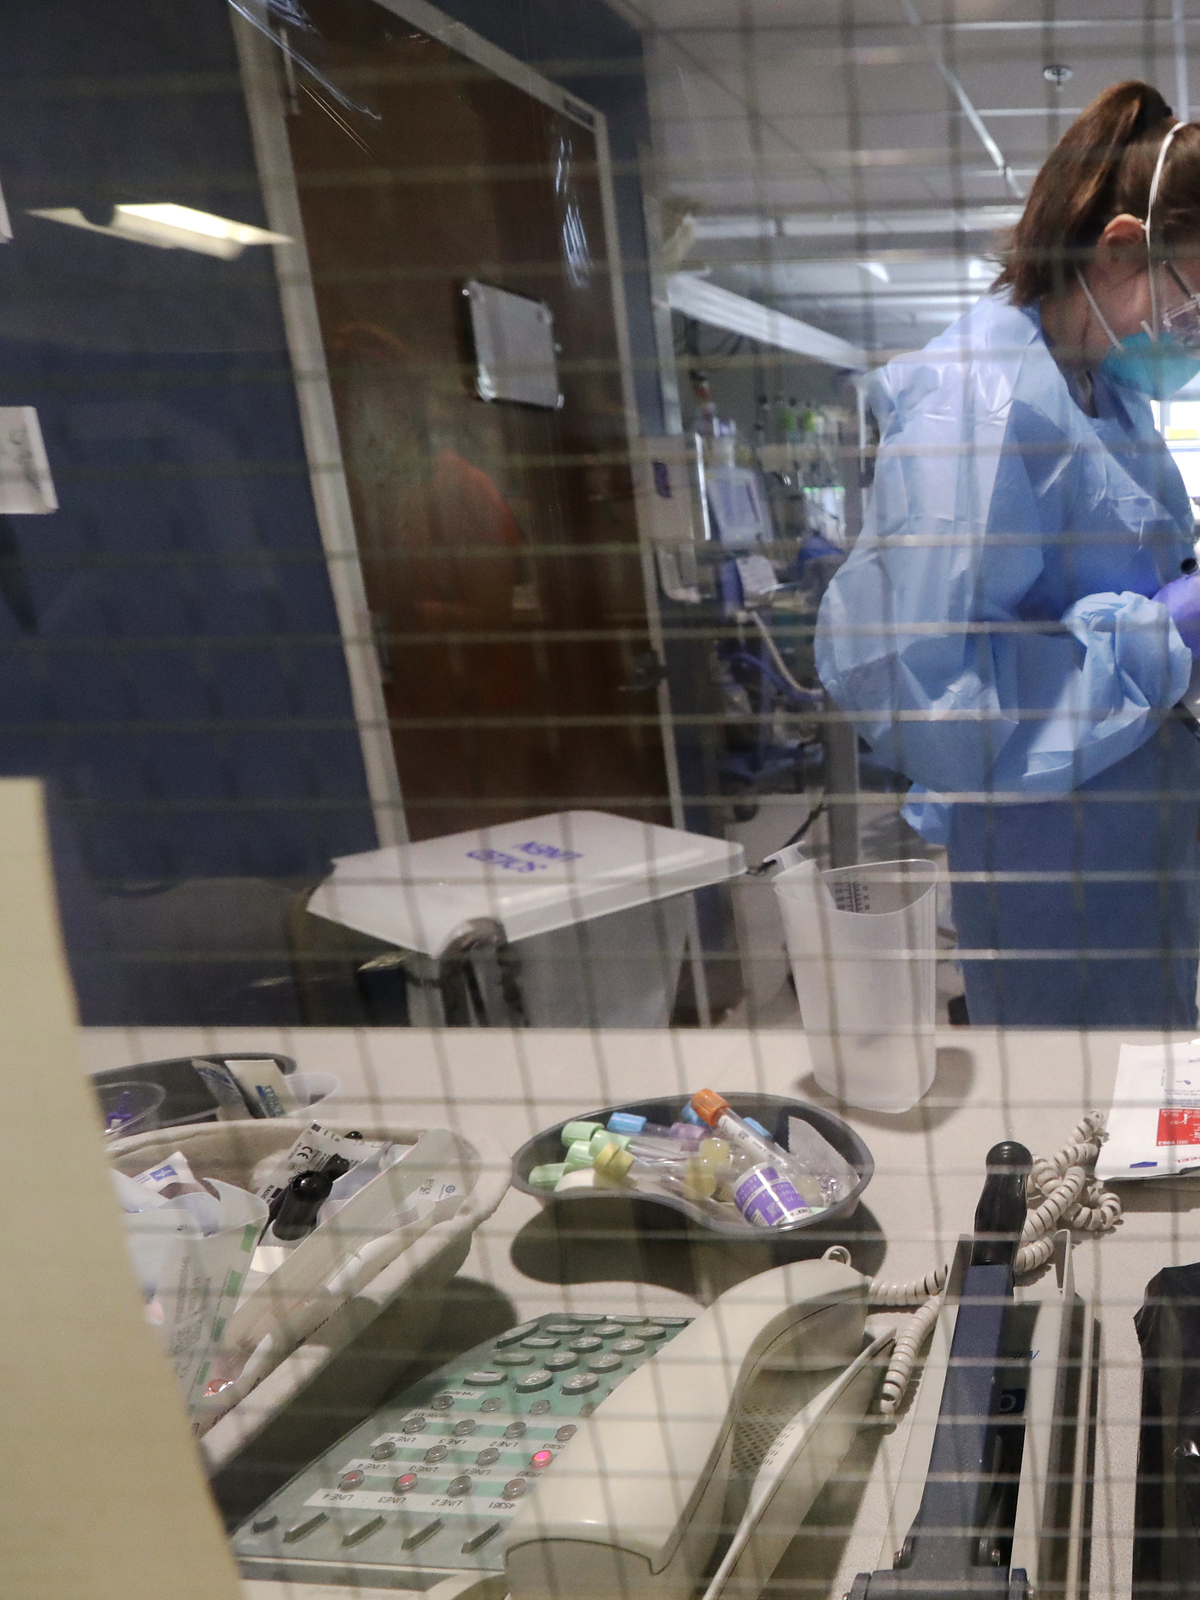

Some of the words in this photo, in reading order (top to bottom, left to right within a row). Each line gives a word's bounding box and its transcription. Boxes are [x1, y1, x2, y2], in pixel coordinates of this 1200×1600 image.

[397, 1435, 417, 1444] LINE
[447, 1438, 468, 1446] LINE
[499, 1440, 520, 1449] LINE
[365, 1463, 387, 1471] LINE
[417, 1466, 439, 1474] LINE
[470, 1468, 492, 1477] LINE
[332, 1493, 355, 1502] LINE
[439, 1499, 463, 1508] LINE
